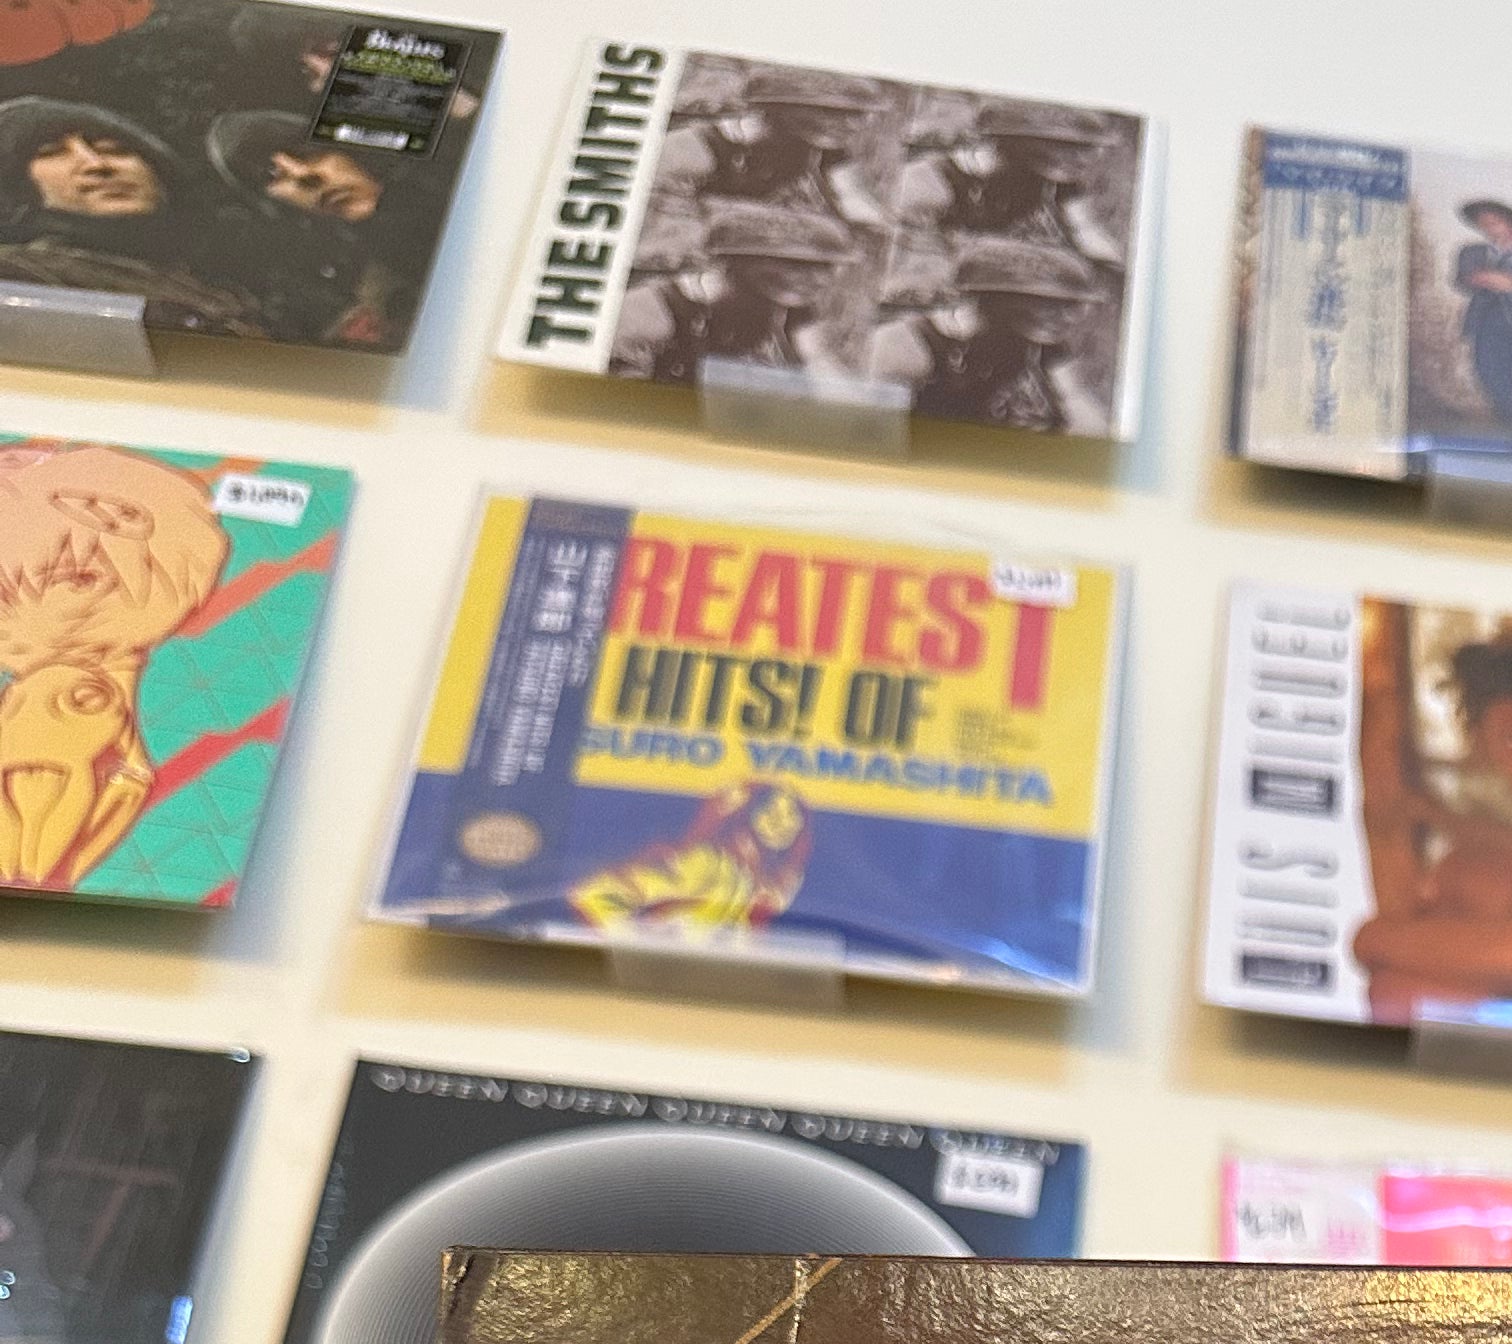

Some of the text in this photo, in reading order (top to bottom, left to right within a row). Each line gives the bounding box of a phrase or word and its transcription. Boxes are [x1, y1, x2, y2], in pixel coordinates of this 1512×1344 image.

[525, 44, 667, 350] THE SMITHS
[608, 535, 1054, 712] REATEST
[615, 646, 824, 737] HITS!
[844, 670, 938, 751] OF
[748, 742, 1054, 807] YAMASHITA
